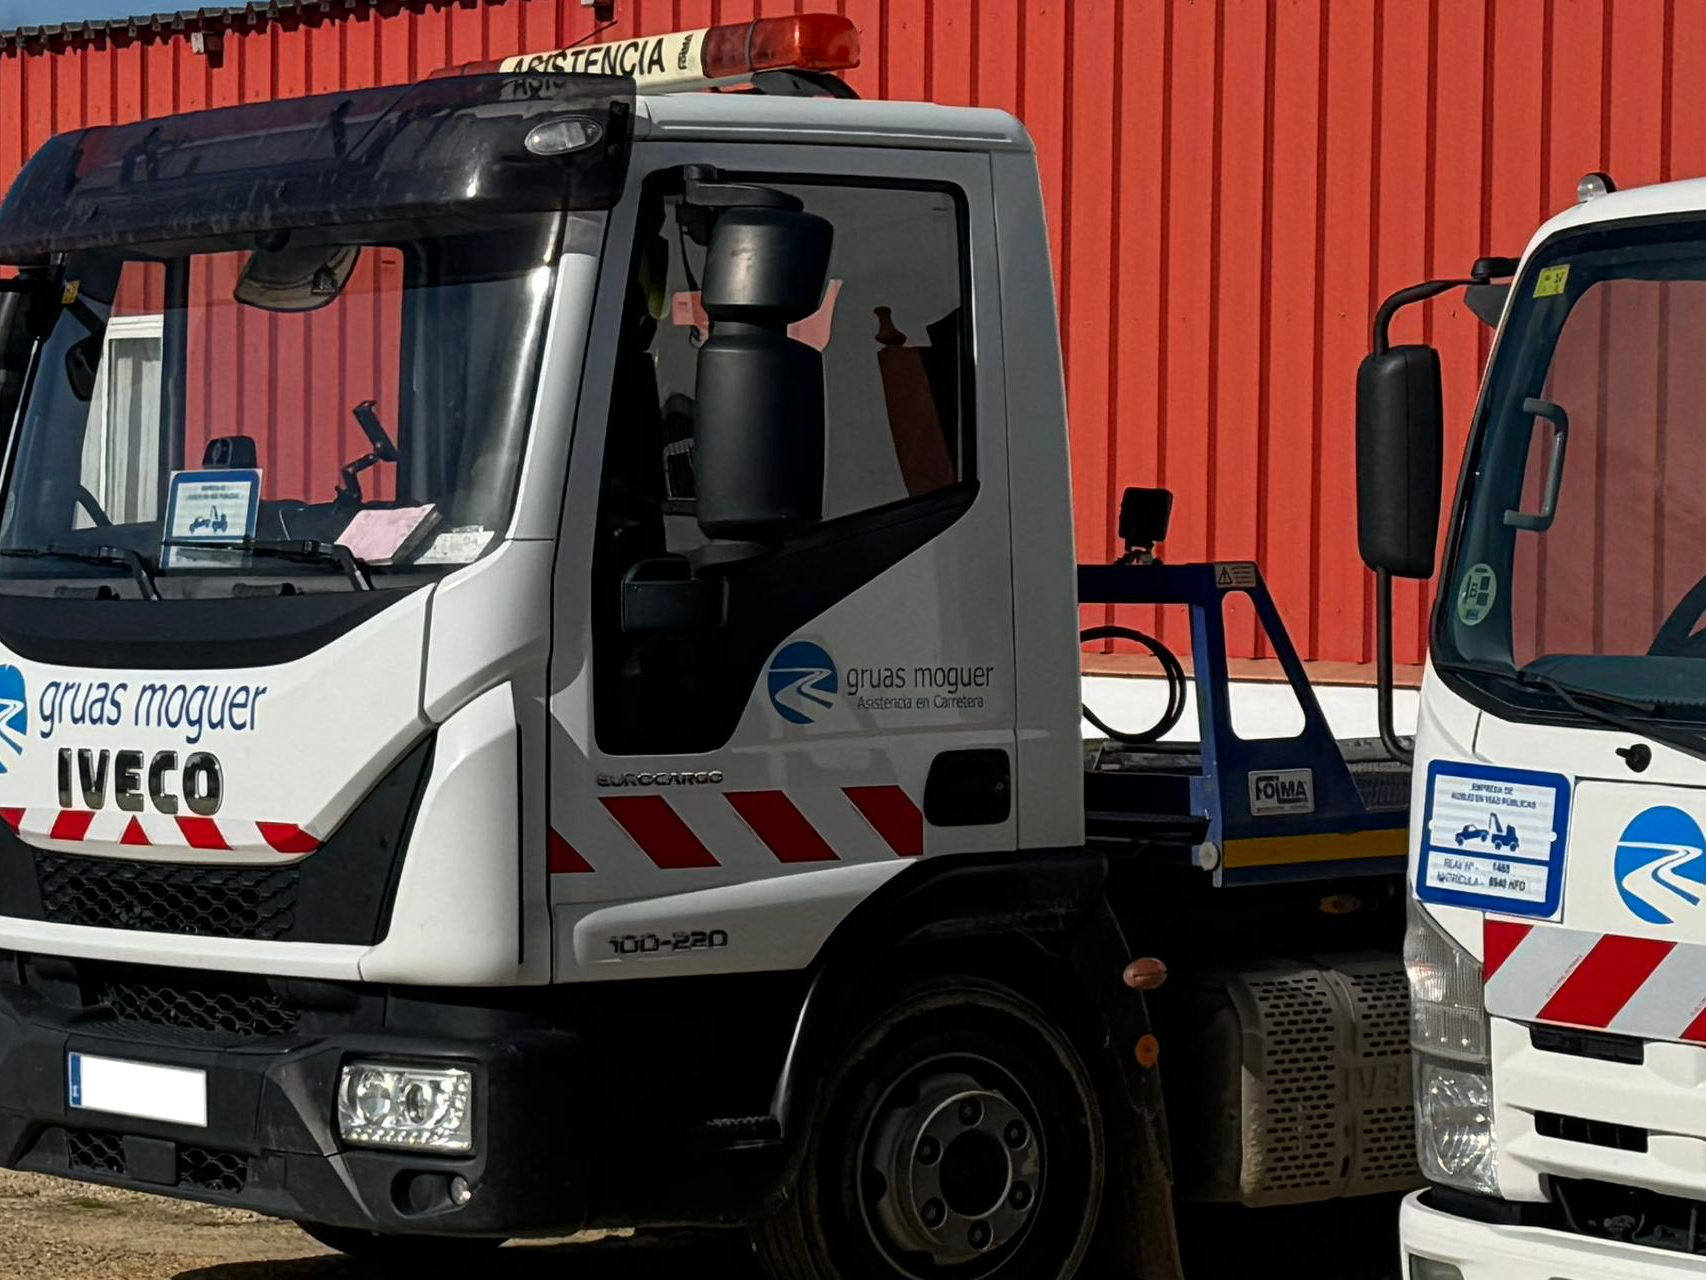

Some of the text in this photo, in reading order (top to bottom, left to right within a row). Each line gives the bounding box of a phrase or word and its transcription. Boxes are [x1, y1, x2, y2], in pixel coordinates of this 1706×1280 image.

[846, 665, 995, 696] gruas moguer
[857, 694, 984, 710] Asistencia en Carretera
[39, 680, 268, 744] gruas moguer
[58, 747, 224, 817] IVECO
